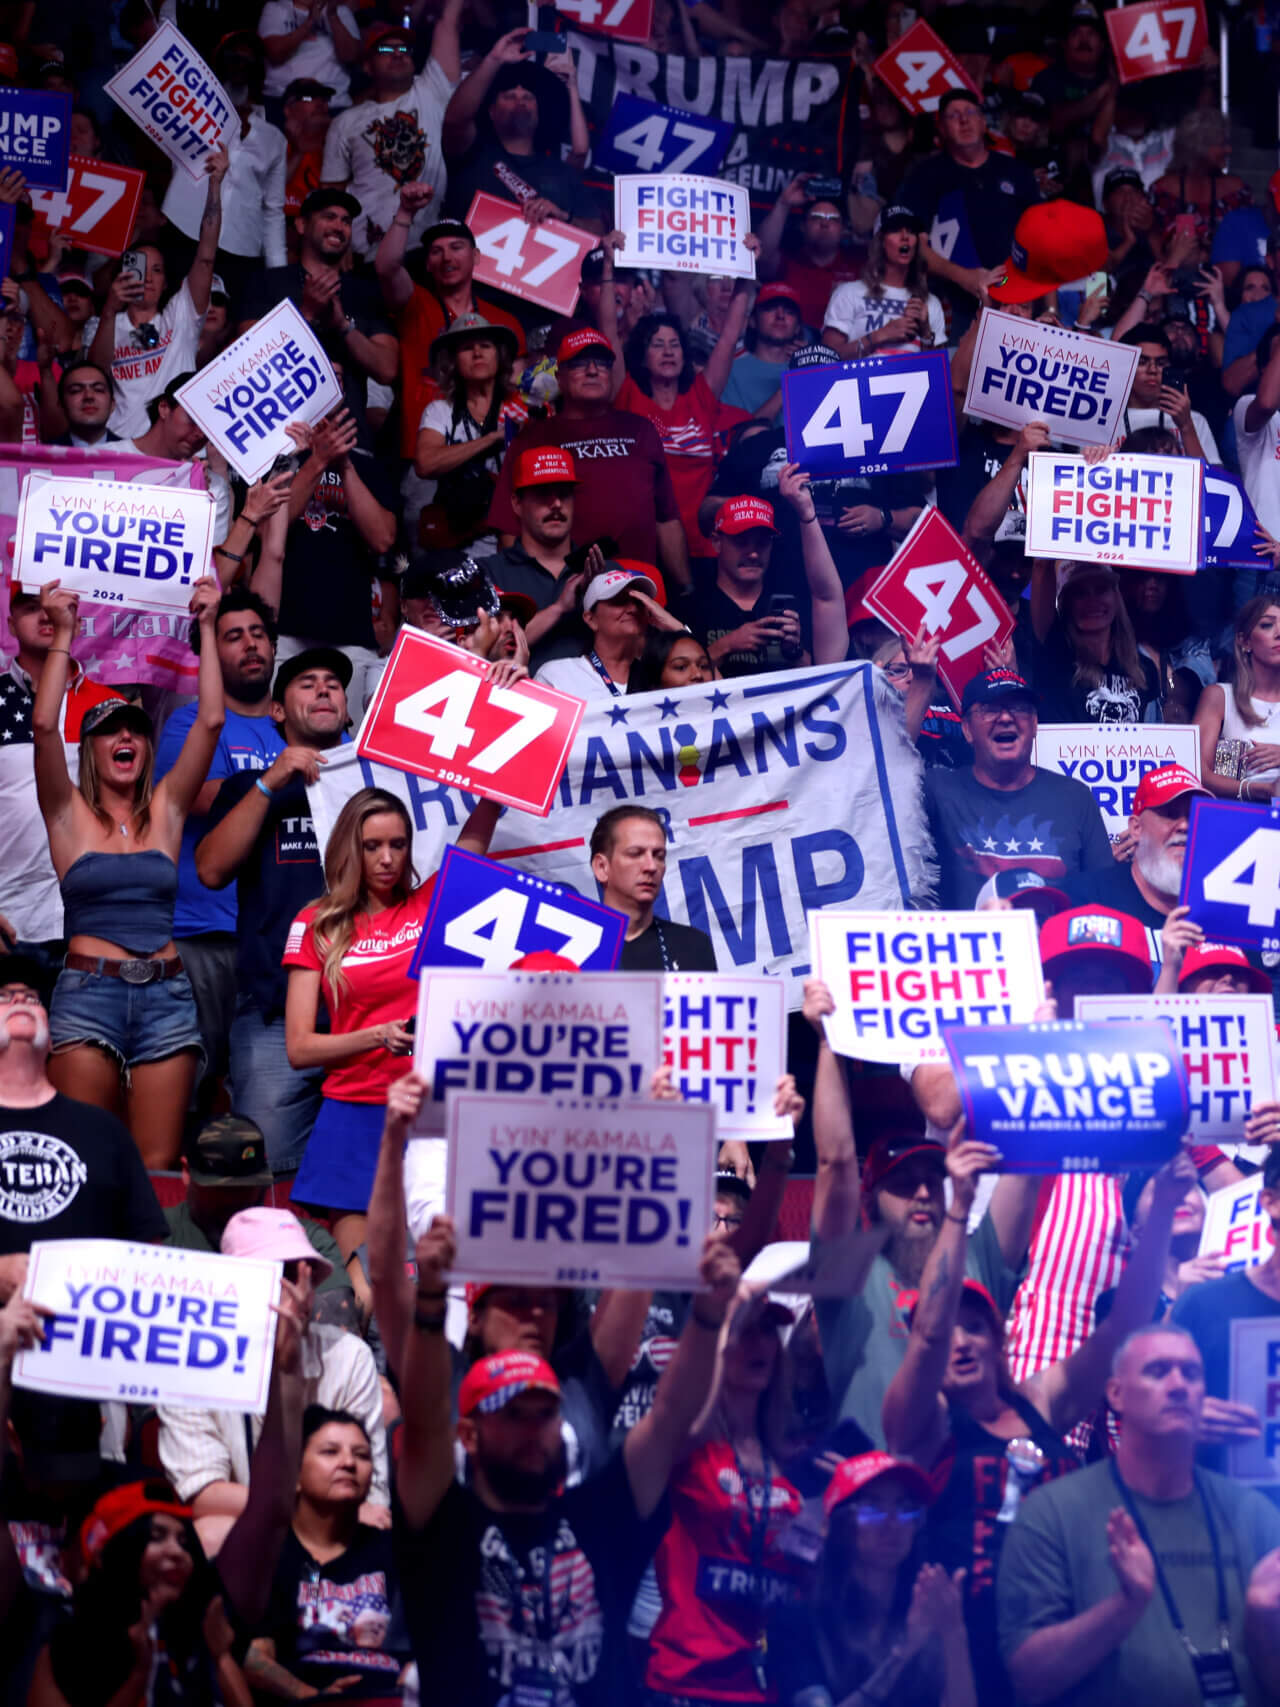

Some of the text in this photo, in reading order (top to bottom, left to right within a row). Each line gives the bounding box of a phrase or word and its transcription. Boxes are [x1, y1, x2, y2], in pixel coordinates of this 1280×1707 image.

[1124, 5, 1199, 63] 47
[162, 44, 231, 129] FIGHT!
[567, 31, 839, 127] TRUMP
[128, 79, 210, 161] FIGHT!
[146, 62, 222, 145] FIGHT!
[614, 114, 716, 175] 47
[637, 185, 736, 215] FIGHT!
[637, 209, 738, 238] FIGHT!
[476, 216, 581, 288] 47
[636, 231, 738, 261] FIGHT!
[206, 329, 292, 406] LYIN' KAMALA
[1001, 333, 1111, 372] LYIN' KAMALA
[213, 339, 307, 422] YOU'RE
[999, 346, 1110, 395] YOU'RE
[224, 356, 328, 455] FIRED!
[981, 367, 1112, 427] FIRED!
[802, 370, 930, 458] 47
[560, 438, 618, 449] FIREFIGHTERS
[577, 444, 630, 459] KARI
[859, 462, 889, 474] 2024
[1053, 465, 1174, 494] FIGHT!
[51, 495, 186, 521] LYIN' KAMALA
[730, 500, 748, 511] MAKE
[734, 511, 754, 521] GREAT
[1052, 492, 1173, 524] FIGHT!
[49, 508, 186, 547] YOU'RE
[1050, 518, 1172, 551] FIGHT!
[33, 532, 194, 585] FIRED!
[1096, 551, 1124, 561] 2024
[92, 590, 124, 602] 2024
[903, 559, 1001, 661] 47
[393, 669, 559, 775] 47
[1059, 745, 1176, 758] LYIN' KAMALA
[436, 767, 471, 789] 2024
[1150, 770, 1173, 784] MAKE
[281, 842, 302, 851] MAKE
[445, 887, 603, 972] 47
[845, 931, 1004, 964] FIGHT!
[849, 968, 1011, 1002] FIGHT!
[455, 999, 629, 1022] LYIN' KAMALA
[452, 1021, 630, 1059] YOU'RE
[965, 1049, 1171, 1089] TRUMP
[996, 1086, 1157, 1119] VANCE
[490, 1126, 678, 1153] LYIN' KAMALA
[991, 1119, 1028, 1132] MAKE
[1030, 1119, 1083, 1132] AMERICA
[1085, 1119, 1119, 1131] GREAT
[488, 1149, 679, 1193] YOU'RE
[1062, 1157, 1100, 1171] 2024
[468, 1191, 692, 1247] FIRED!
[132, 1267, 239, 1300] KAMALA
[555, 1267, 600, 1282] 2024
[63, 1282, 240, 1331] YOU'RE
[39, 1314, 250, 1375] FIRED!
[117, 1383, 160, 1399] 2024
